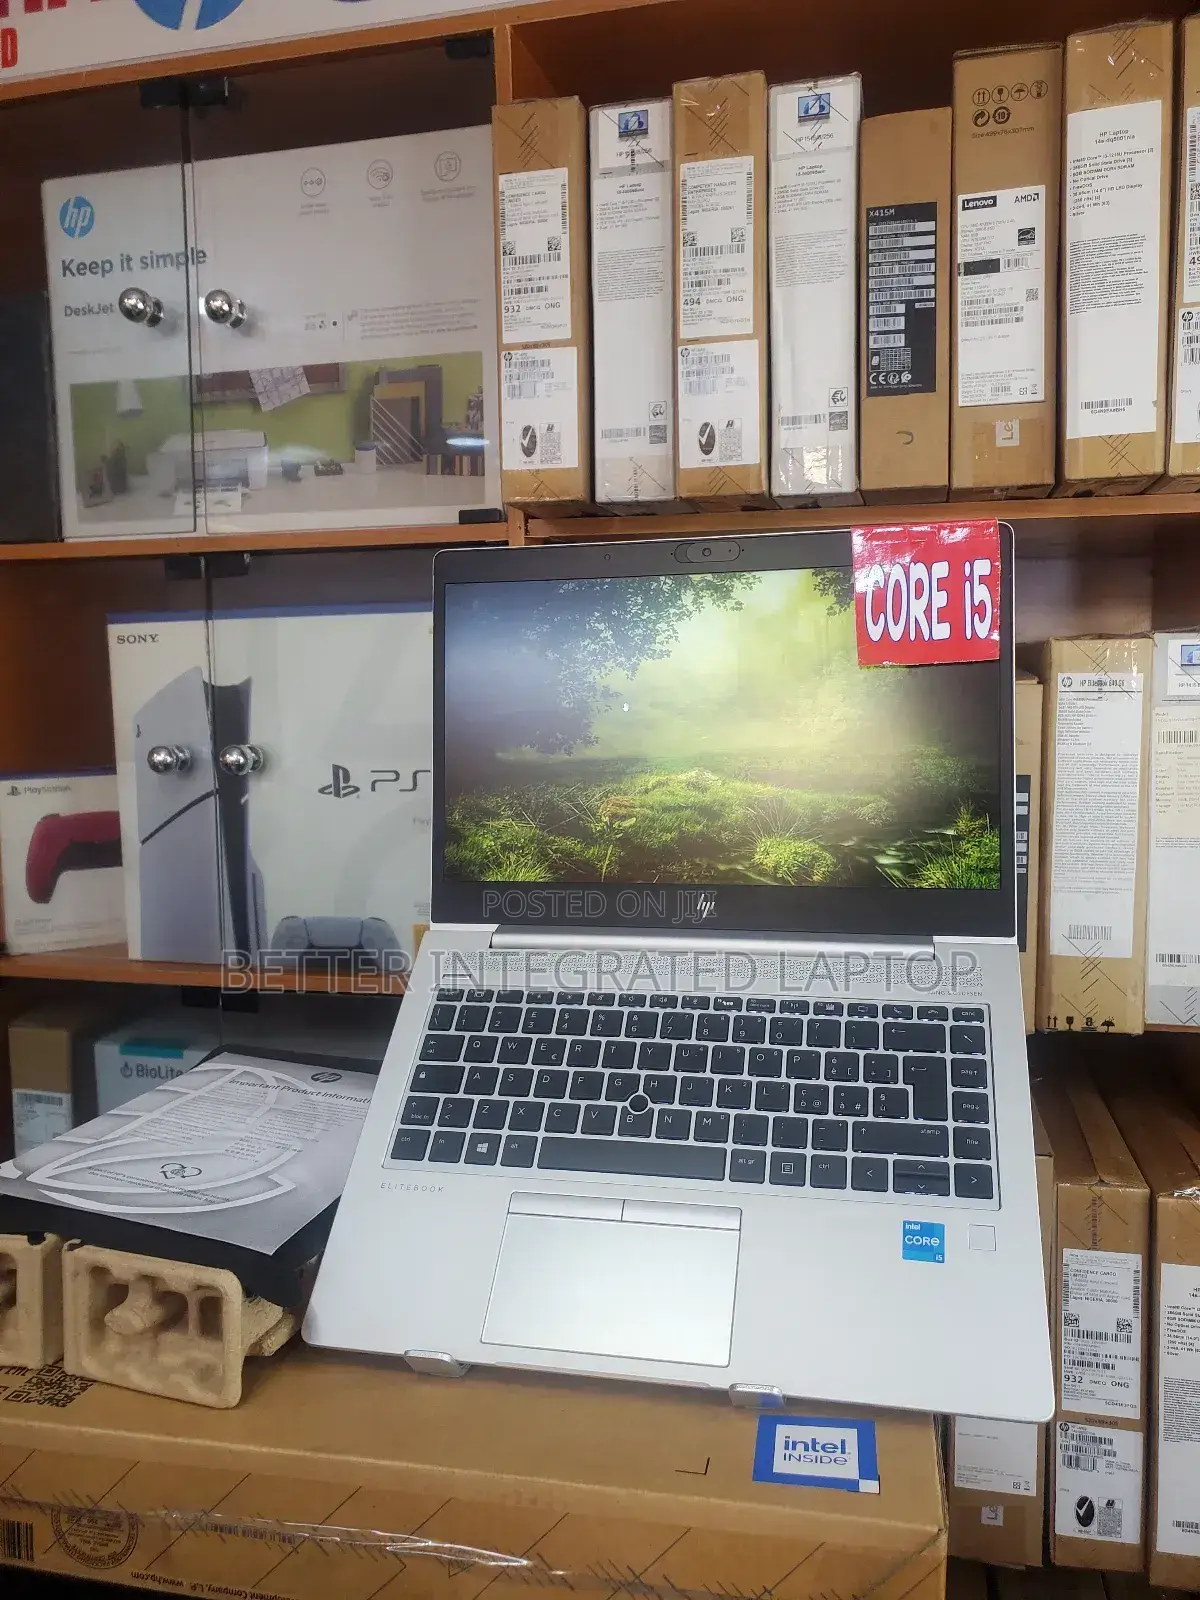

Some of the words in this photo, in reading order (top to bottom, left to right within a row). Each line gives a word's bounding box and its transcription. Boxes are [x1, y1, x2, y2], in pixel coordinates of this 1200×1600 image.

[964, 198, 994, 209] Lenovo
[1014, 194, 1033, 204] AMD
[59, 195, 96, 240] hp
[868, 208, 895, 218] X415M
[60, 257, 115, 278] Keep
[119, 252, 134, 273] it
[139, 246, 208, 272] simple
[503, 304, 521, 315] 932
[544, 301, 562, 310] ONG
[682, 297, 702, 307] 494
[726, 295, 745, 304] ONG
[64, 302, 115, 318] DeskJet
[863, 559, 951, 643] CORE
[963, 557, 993, 641] i5
[116, 632, 159, 645] SONY
[228, 1078, 280, 1091] Important
[280, 1084, 322, 1097] Product
[380, 1182, 445, 1193] ELITEBOOK
[905, 1222, 921, 1231] intel
[904, 1234, 940, 1247] CORE
[1063, 1374, 1084, 1384] 932
[1110, 1380, 1130, 1389] ONG
[783, 1435, 848, 1455] intel
[783, 1452, 849, 1466] INSIDE
[130, 1570, 185, 1588] www.hp.com
